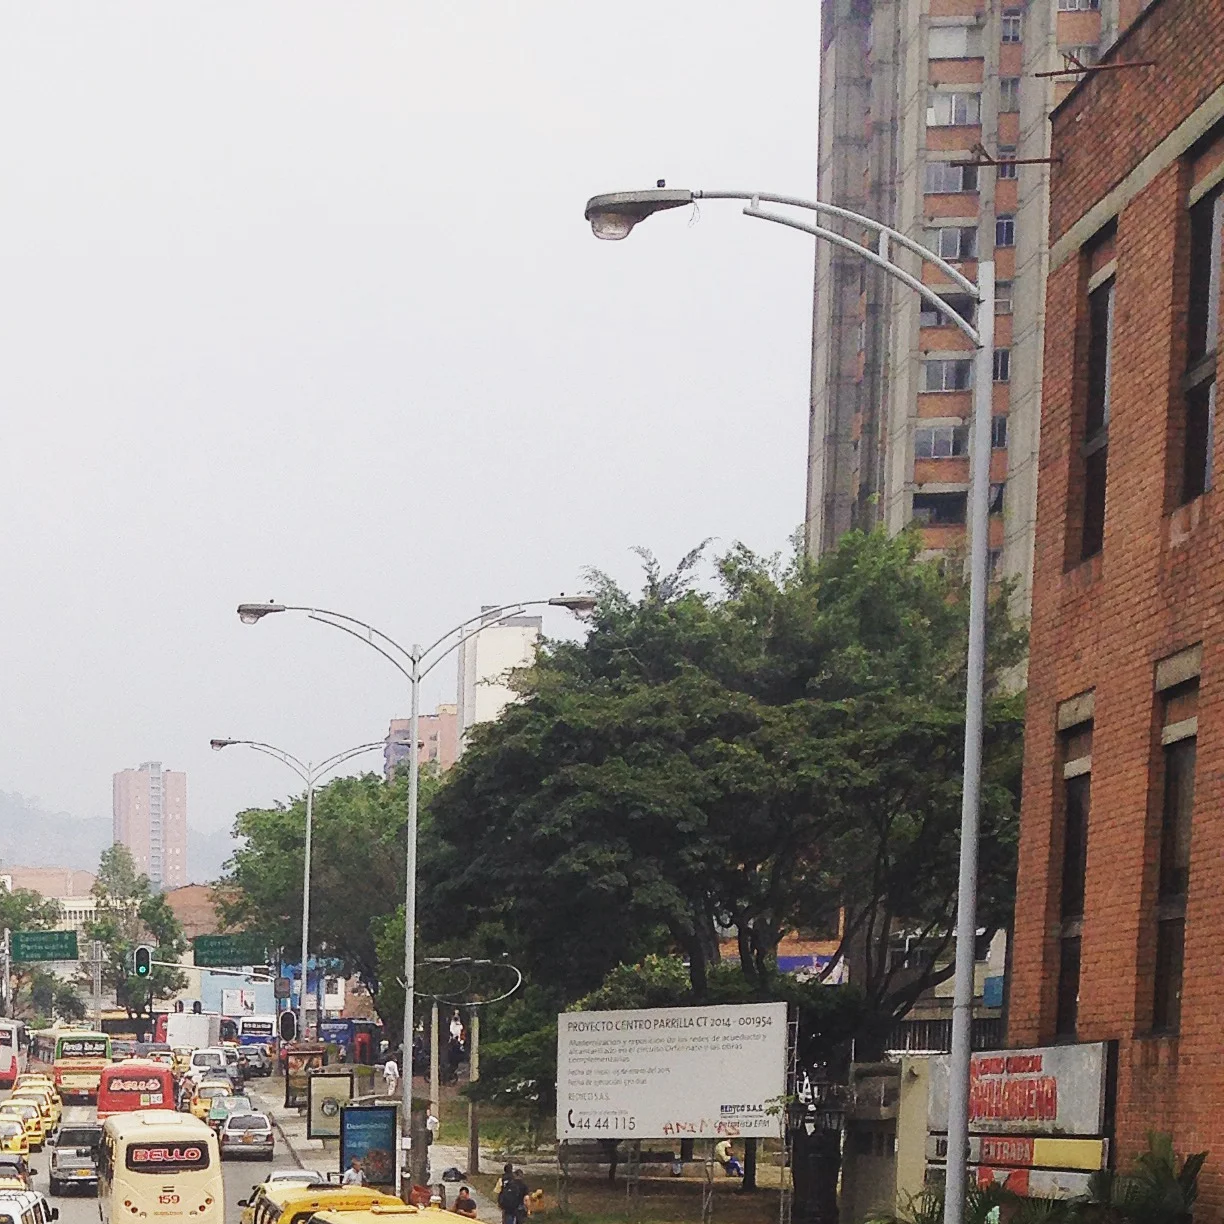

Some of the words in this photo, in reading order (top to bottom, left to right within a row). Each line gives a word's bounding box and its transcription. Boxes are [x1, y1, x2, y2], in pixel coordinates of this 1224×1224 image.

[567, 1021, 613, 1032] PROYECTO
[615, 1019, 652, 1031] CENTRO
[653, 1018, 694, 1029] PARRILLA
[696, 1016, 709, 1028] CT
[710, 1017, 732, 1028] 2014
[738, 1016, 773, 1028] 001954
[576, 1118, 591, 1130] 44
[594, 1118, 610, 1130] 44
[615, 1117, 636, 1131] 115
[133, 1148, 202, 1162] BELLO
[982, 1139, 1032, 1162] ENTRADA
[158, 1194, 181, 1205] 159
